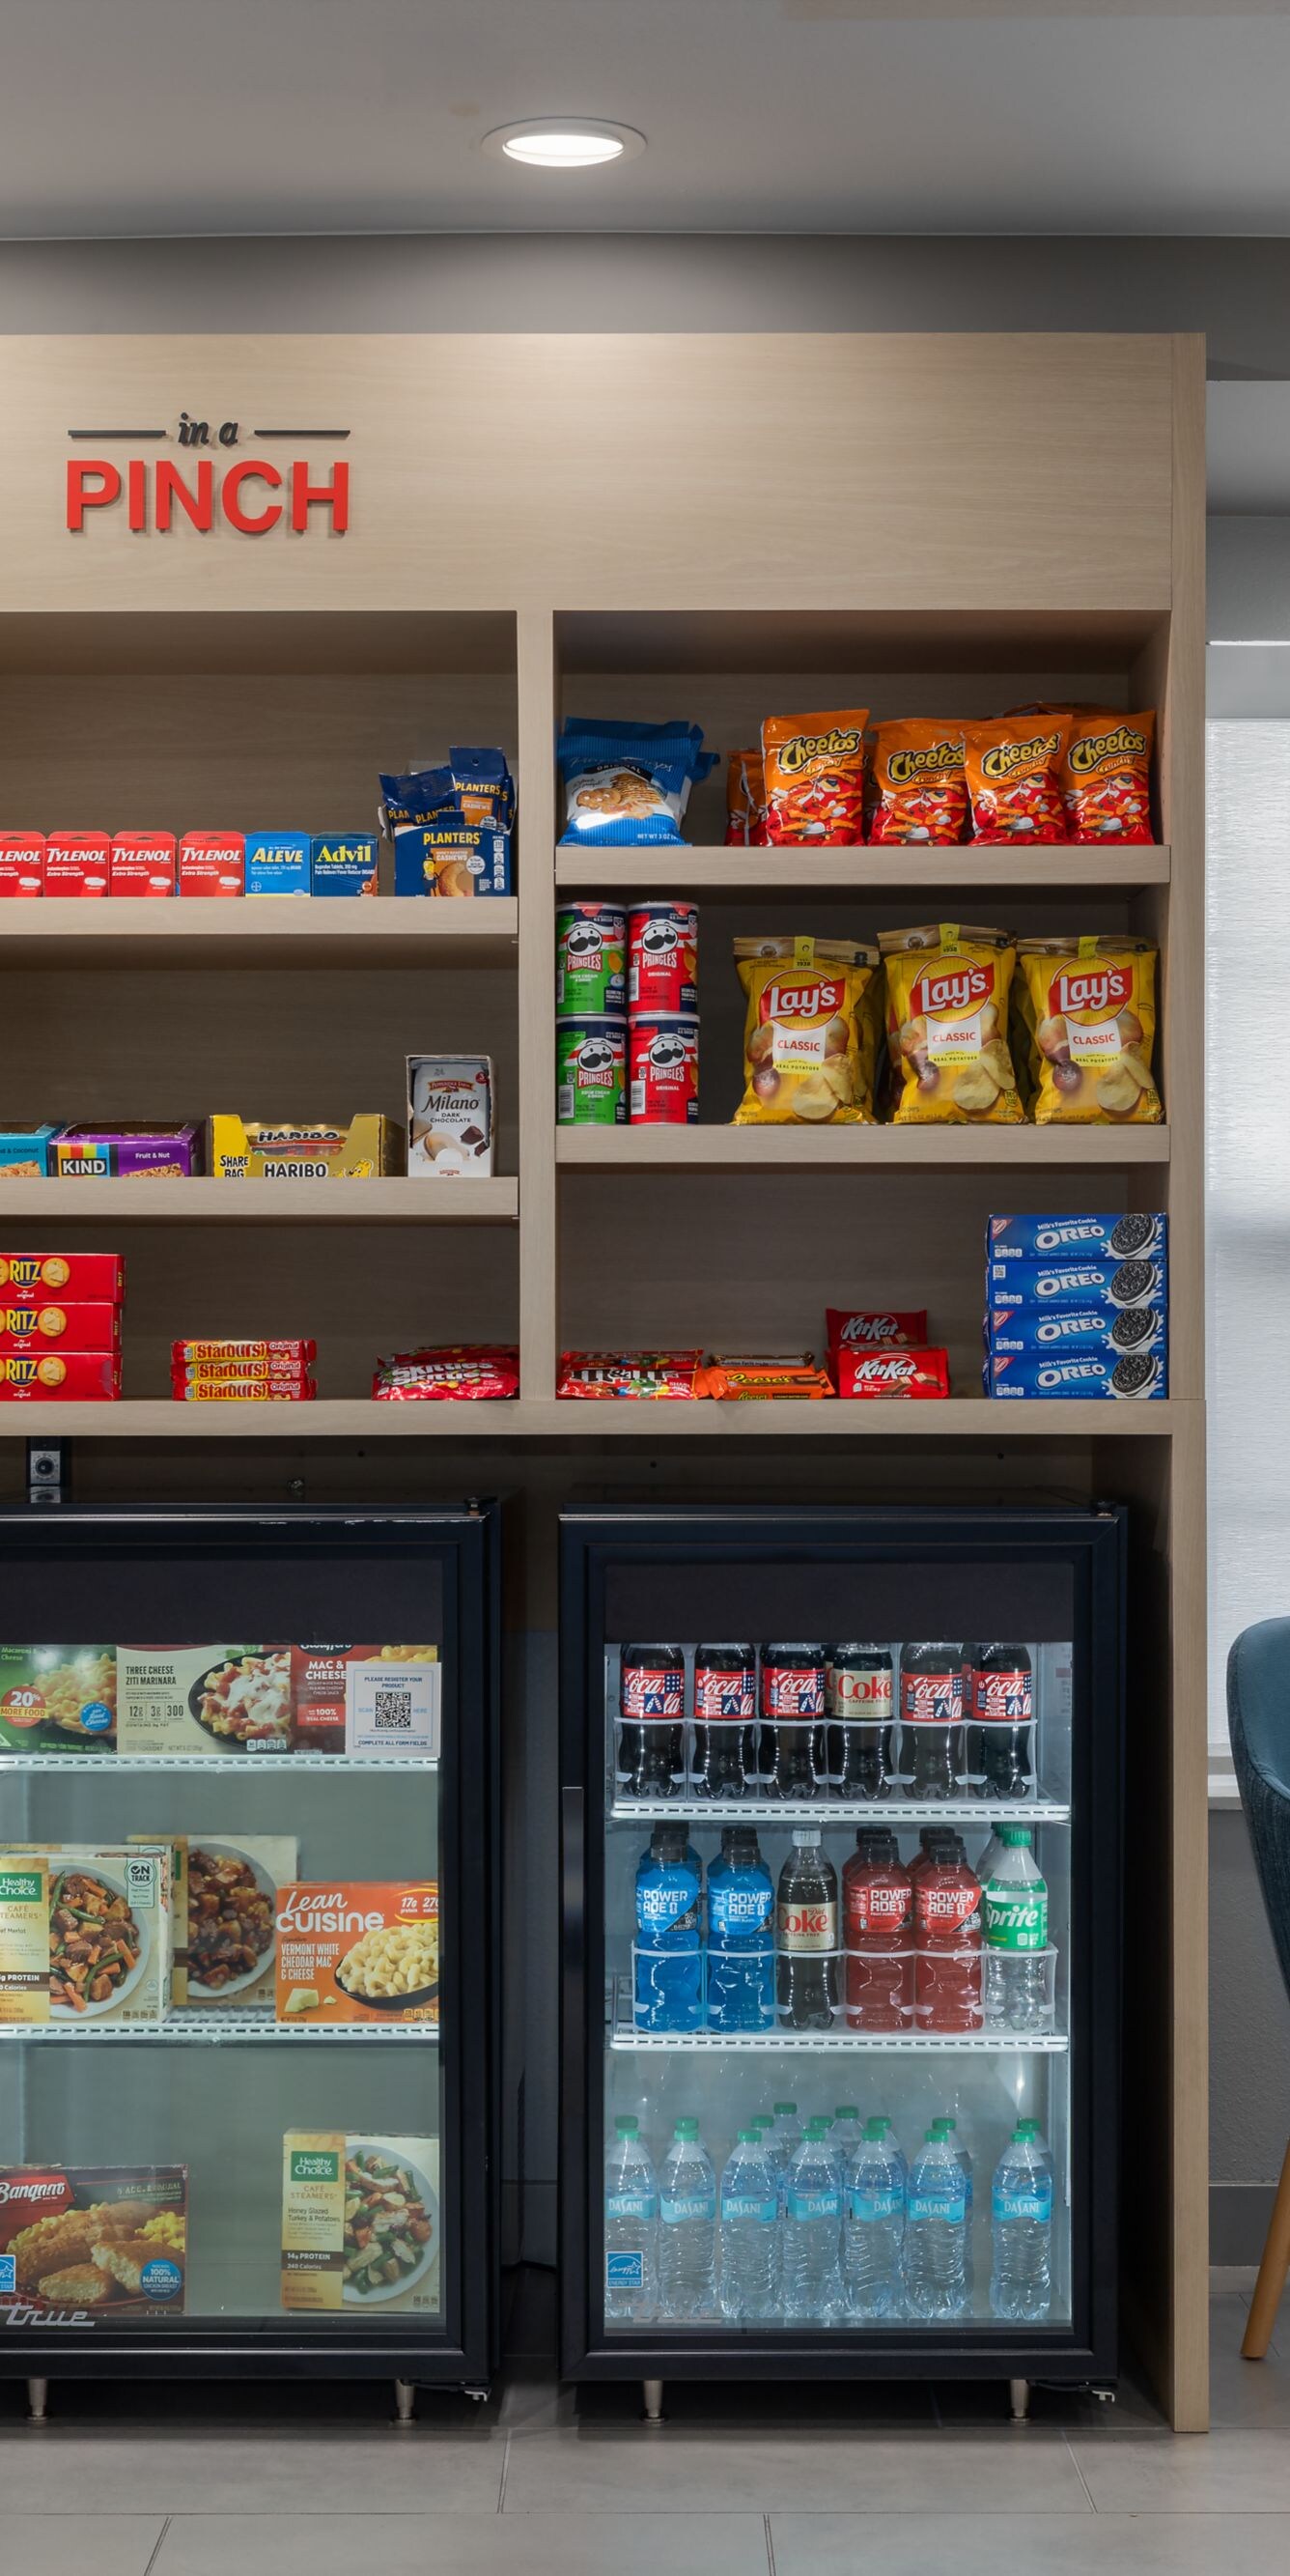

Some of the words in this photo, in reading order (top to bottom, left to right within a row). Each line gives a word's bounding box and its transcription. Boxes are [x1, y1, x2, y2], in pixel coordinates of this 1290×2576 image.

[178, 412, 209, 443] in
[218, 421, 238, 444] a
[67, 460, 349, 532] PINCH
[780, 729, 858, 772] Cheetos
[983, 734, 1059, 778] Cheetos
[1069, 726, 1146, 774] Cheetos
[889, 742, 965, 783] Cheetos
[455, 782, 501, 795] PLANTERS
[423, 833, 480, 845] PLANTERS
[46, 848, 106, 863] TYLENOL
[112, 848, 171, 863] TYLENOL
[182, 847, 240, 863] TYLENOL
[251, 847, 304, 863] ALEVE
[316, 845, 371, 863] Advil
[566, 954, 602, 971] PRINGLES
[641, 952, 677, 969] PRINGLES
[921, 968, 987, 1012] Lay's
[1060, 969, 1124, 1011] Lay's
[770, 981, 836, 1018] Lay's
[933, 1032, 976, 1042] CLASSIC
[1073, 1033, 1116, 1045] CLASSIC
[777, 1040, 821, 1052] CLASSIC
[578, 1071, 613, 1088] PRINGLES
[650, 1066, 685, 1083] PRINGLES
[421, 1095, 479, 1113] Milano
[259, 1132, 338, 1142] HARIBO
[63, 1160, 105, 1175] KIND
[220, 1156, 248, 1167] SHARE
[224, 1169, 244, 1177] BAG
[265, 1164, 327, 1177] HARIBO
[1035, 1226, 1105, 1250] OREO
[10, 1260, 41, 1282] RITZ
[1035, 1272, 1105, 1297] OREO
[7, 1310, 38, 1331] RITZ
[1036, 1317, 1106, 1343] OREO
[196, 1344, 266, 1358] Starburst
[270, 1342, 298, 1350] Original
[6, 1359, 38, 1380] RITZ
[199, 1363, 267, 1377] Starburst
[271, 1362, 300, 1371] Original
[1037, 1364, 1107, 1389] OREO
[198, 1383, 266, 1398] Starburst
[271, 1382, 300, 1391] Original
[126, 1666, 147, 1675] THREE
[149, 1665, 174, 1675] CHEESE
[336, 1660, 344, 1669] &
[126, 1677, 139, 1685] ZITI
[141, 1676, 177, 1685] MARINARA
[305, 1671, 347, 1680] CHEESE
[838, 1675, 892, 1698] Coke
[1, 1708, 22, 1716] MORE
[167, 1705, 183, 1716] 300
[0, 1885, 37, 1895] Choice
[2, 1879, 35, 1887] Healthy
[644, 1890, 687, 1902] POWER
[729, 1892, 771, 1904] POWER
[871, 1889, 911, 1900] POWER
[929, 1890, 974, 1902] POWER
[286, 1891, 348, 1913] Lean
[644, 1902, 666, 1912] ADE
[729, 1904, 755, 1914] ADE
[871, 1901, 896, 1912] ADE
[929, 1902, 954, 1913] ADE
[778, 1907, 827, 1933] Coke
[986, 1903, 1038, 1929] Sprite
[281, 1944, 315, 1955] VERMONT
[317, 1944, 339, 1955] WHITE
[281, 1956, 315, 1967] CHEDDAR
[316, 1956, 331, 1967] MAC
[281, 1968, 287, 1980] &
[288, 1968, 315, 1980] CHEESE
[299, 2157, 331, 2166] Healthy
[294, 2165, 333, 2175] Choice
[0, 2182, 66, 2203] Banquet
[303, 2184, 324, 2193] CAFÉ
[609, 2200, 642, 2213] DASANI
[675, 2201, 709, 2214] DASANI
[726, 2200, 761, 2213] DASANI
[916, 2200, 950, 2213] DASANI
[1004, 2200, 1039, 2213] DASANI
[0, 2303, 96, 2327] true
